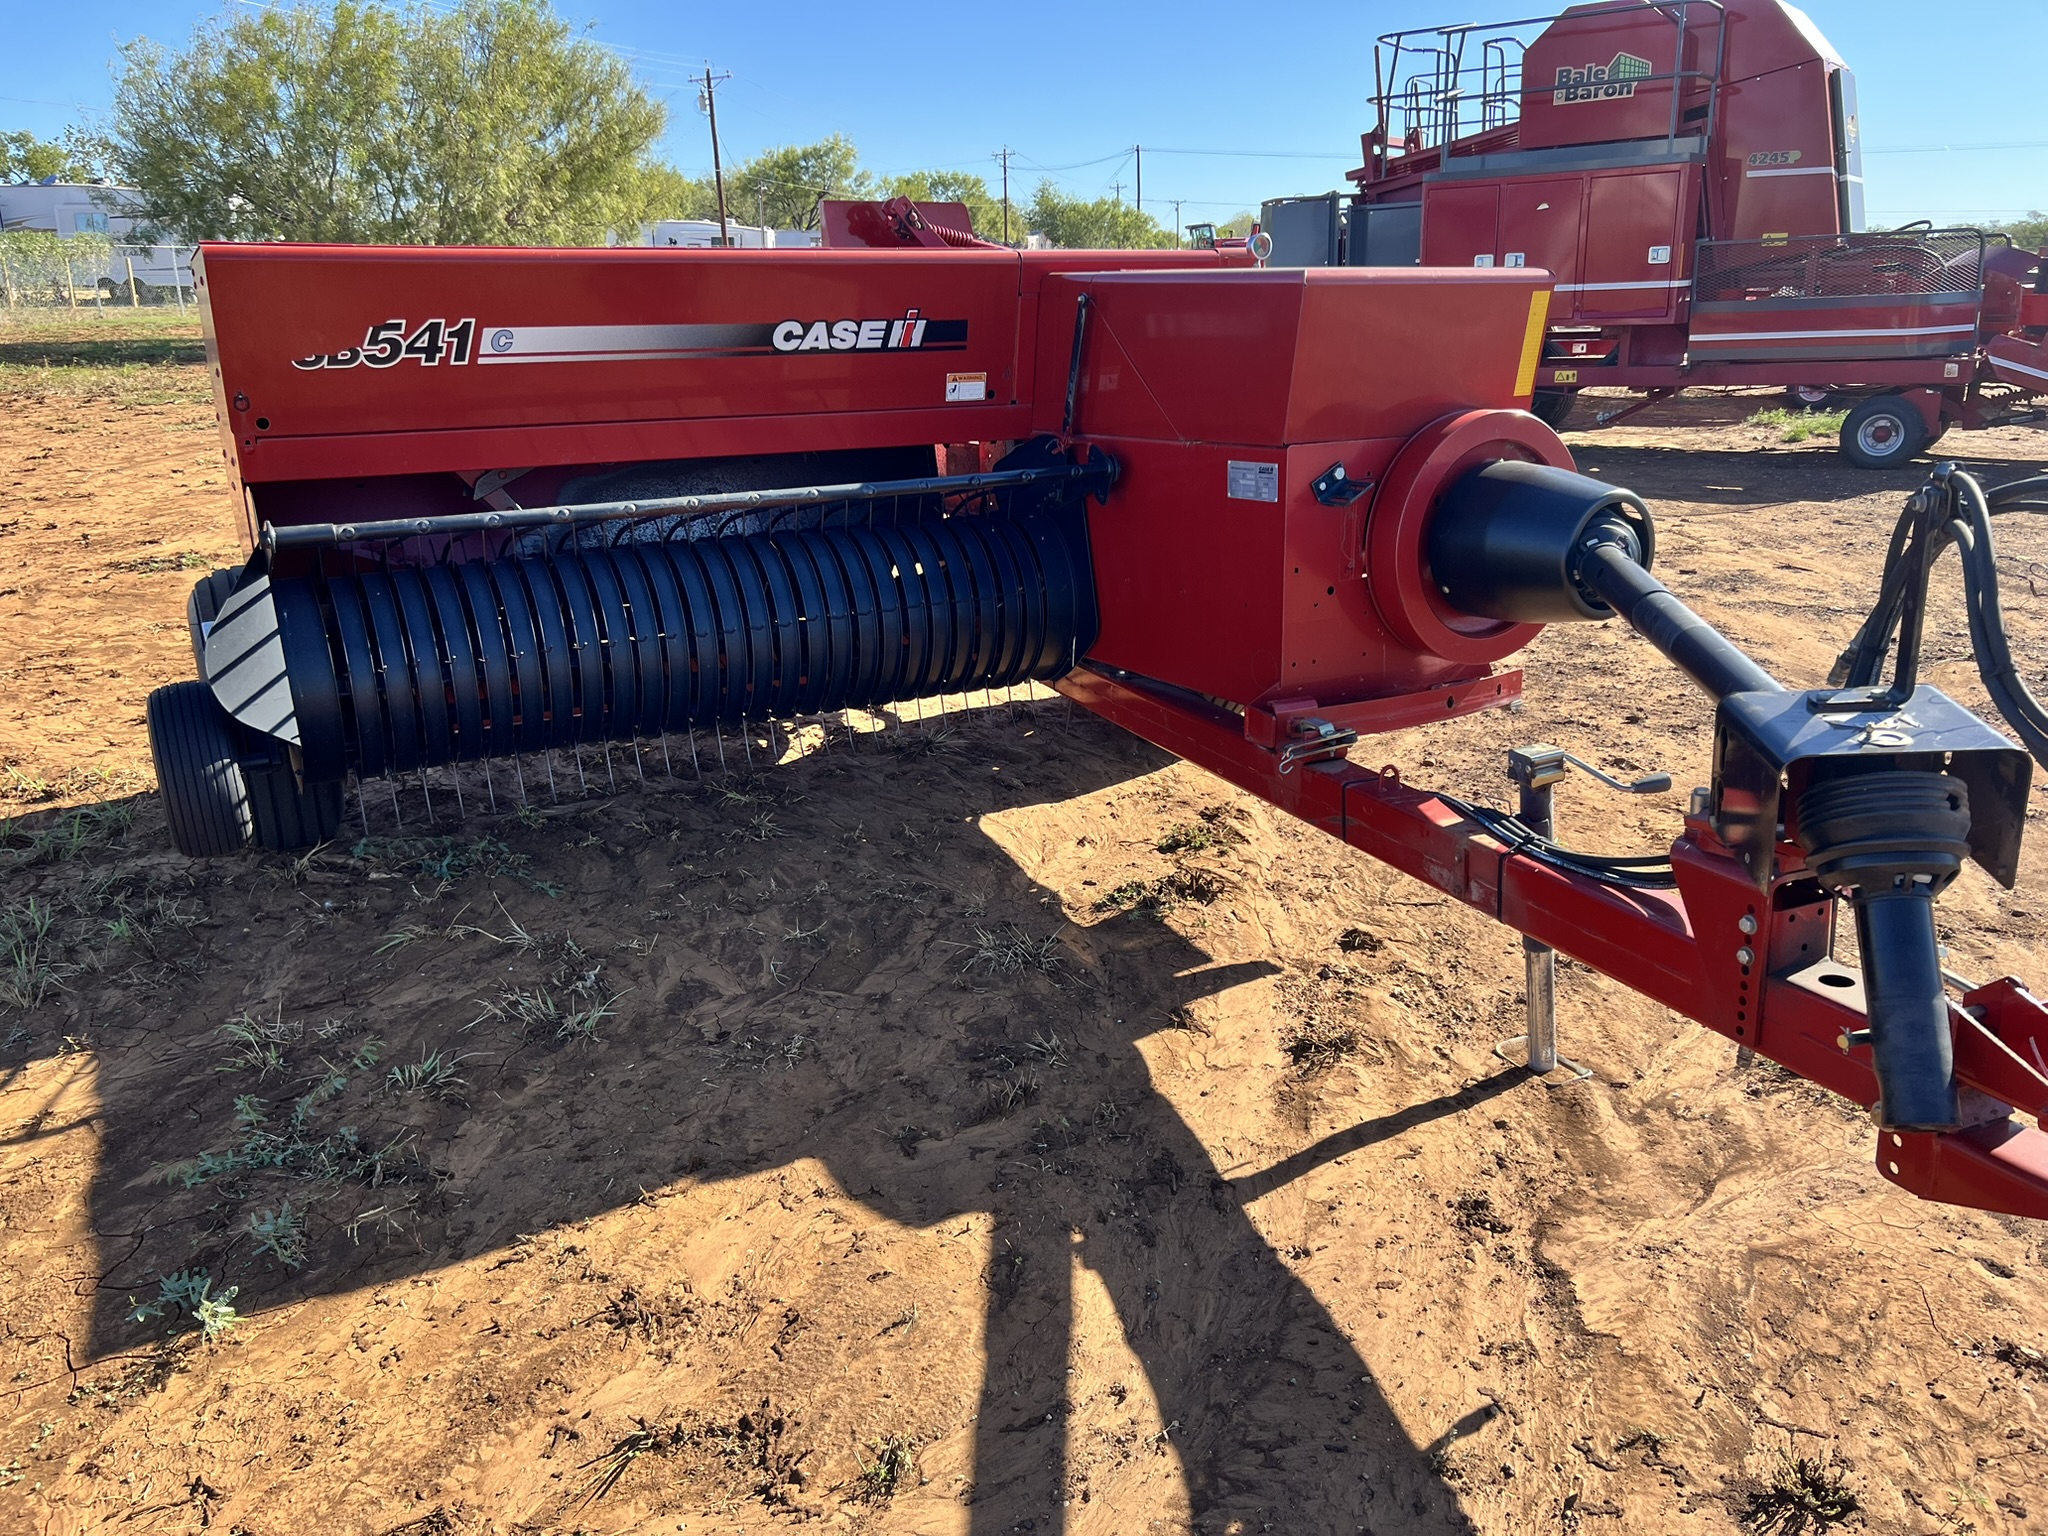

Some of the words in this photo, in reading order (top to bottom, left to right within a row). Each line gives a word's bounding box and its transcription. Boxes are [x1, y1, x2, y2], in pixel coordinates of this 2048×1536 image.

[1557, 65, 1607, 84] Bale
[1564, 82, 1634, 102] Baron
[491, 329, 514, 352] C
[773, 320, 887, 351] CASE
